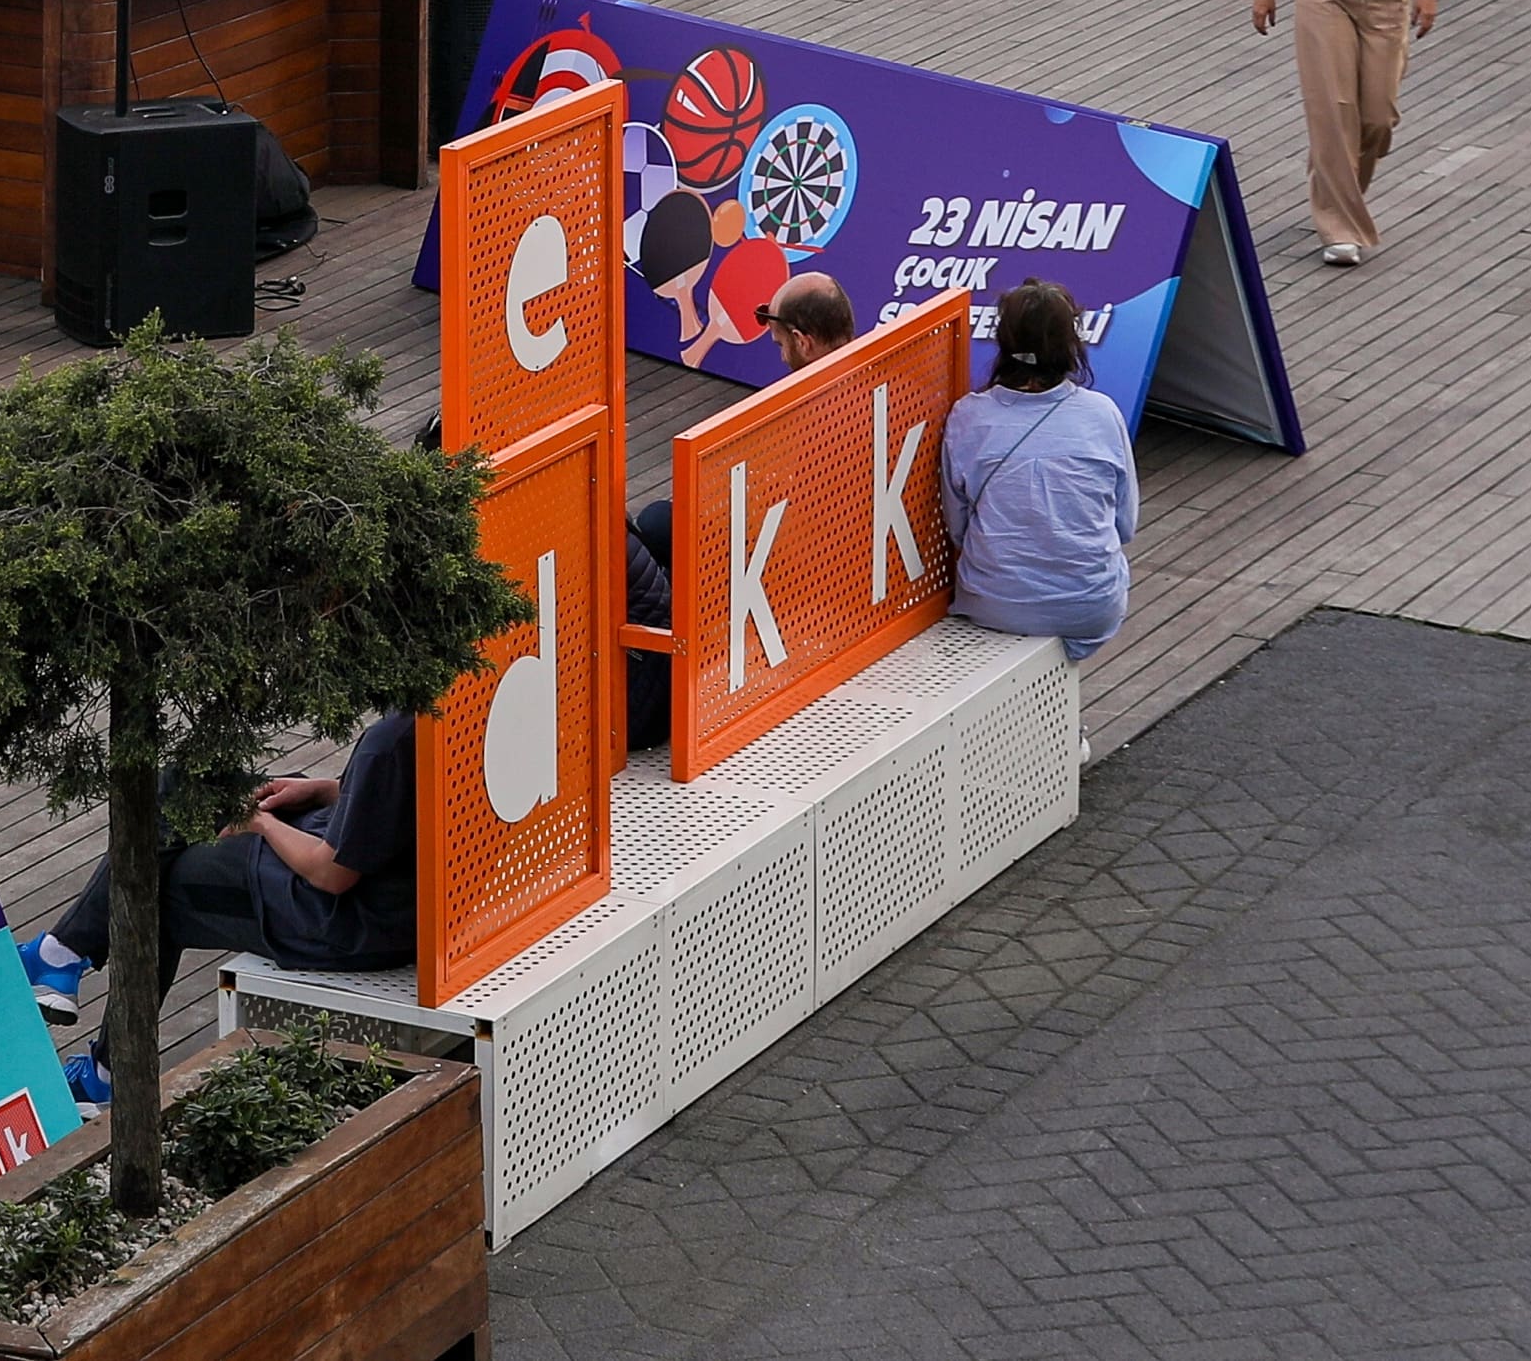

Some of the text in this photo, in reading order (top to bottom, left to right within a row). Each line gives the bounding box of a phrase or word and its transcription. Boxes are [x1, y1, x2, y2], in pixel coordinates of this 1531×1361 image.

[908, 189, 1126, 250] 23 NİSAN
[893, 255, 998, 297] ÇOCUK
